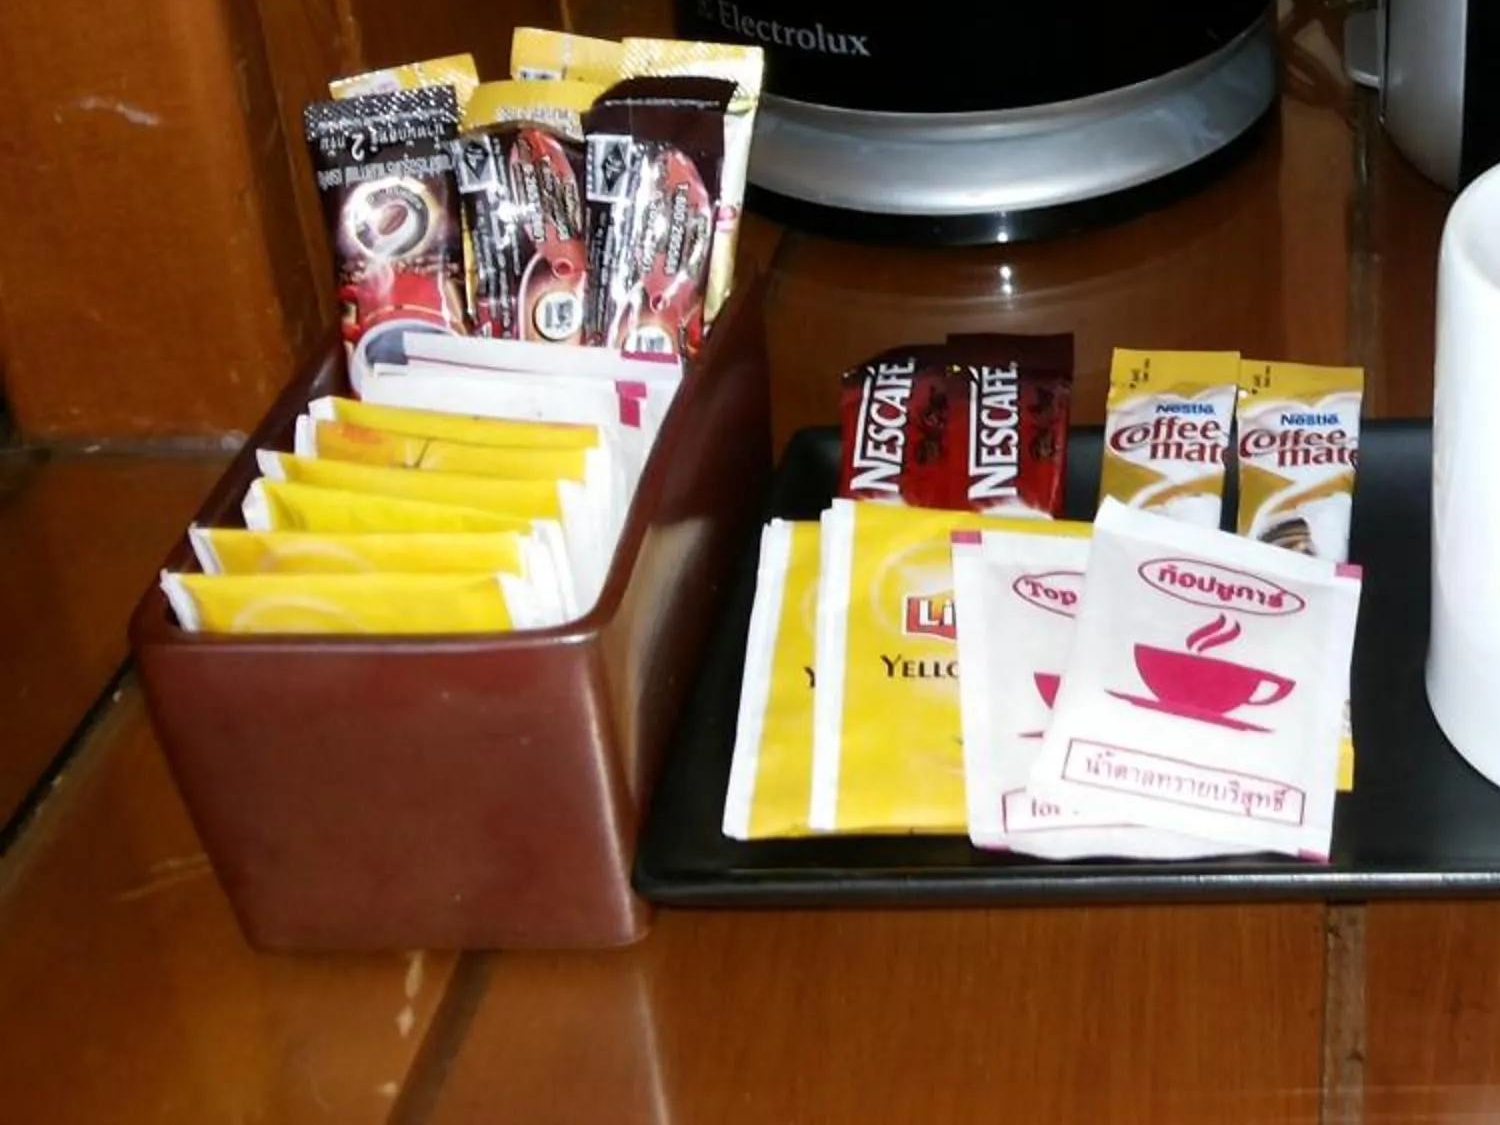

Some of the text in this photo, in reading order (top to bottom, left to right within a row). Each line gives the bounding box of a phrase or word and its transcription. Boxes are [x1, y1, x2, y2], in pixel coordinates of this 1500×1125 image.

[350, 133, 366, 161] 2
[968, 362, 1020, 499] NESCAFÉ
[1109, 416, 1221, 452] Coffee
[1239, 428, 1347, 459] Coffee
[1024, 579, 1077, 606] Top
